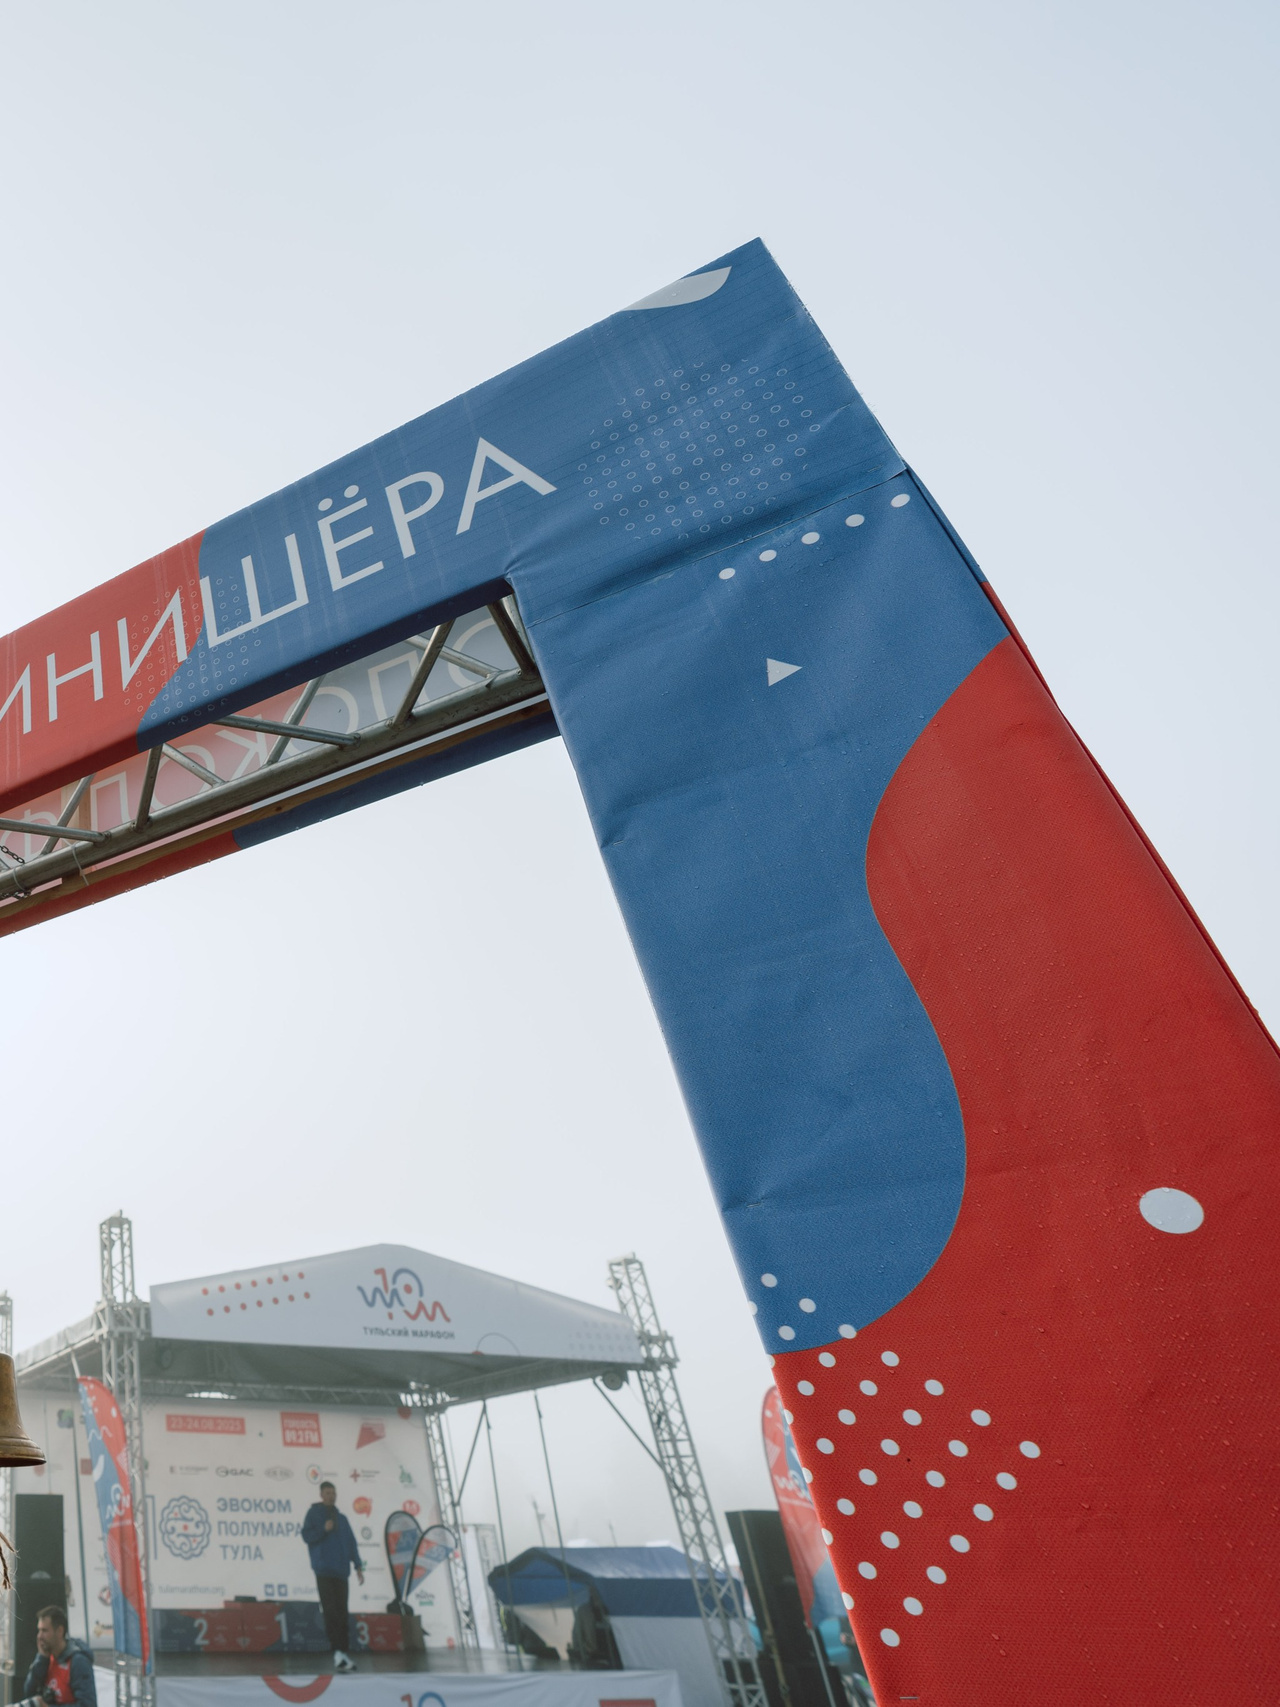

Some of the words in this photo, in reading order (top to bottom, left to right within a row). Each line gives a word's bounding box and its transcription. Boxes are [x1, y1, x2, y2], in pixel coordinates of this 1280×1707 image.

[362, 1326, 410, 1338] ТУЛЬСКИЙ
[412, 1330, 456, 1340] МАРАФОН
[216, 1497, 292, 1513] ЭВОКОМ
[217, 1521, 303, 1537] ПОЛУМАРА
[219, 1544, 264, 1560] ТУЛА
[193, 1618, 209, 1645] 2
[274, 1611, 288, 1644] 1
[356, 1621, 370, 1645] 3
